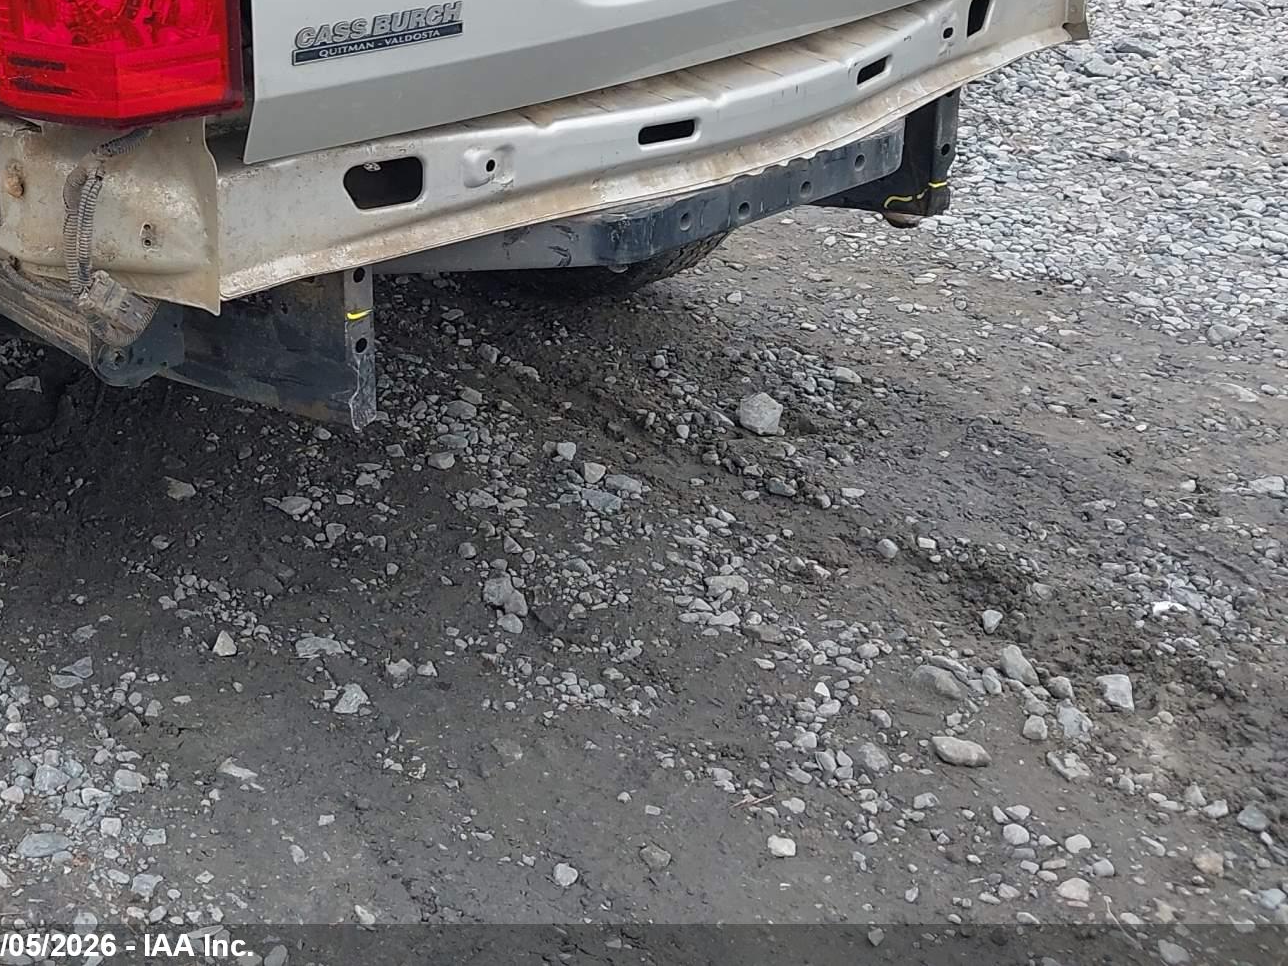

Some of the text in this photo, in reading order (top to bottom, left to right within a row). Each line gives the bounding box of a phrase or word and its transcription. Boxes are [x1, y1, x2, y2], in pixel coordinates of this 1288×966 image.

[295, 0, 463, 49] CASS BURCH
[318, 40, 375, 59] QUITMAN
[384, 29, 441, 47] VALDOSTA
